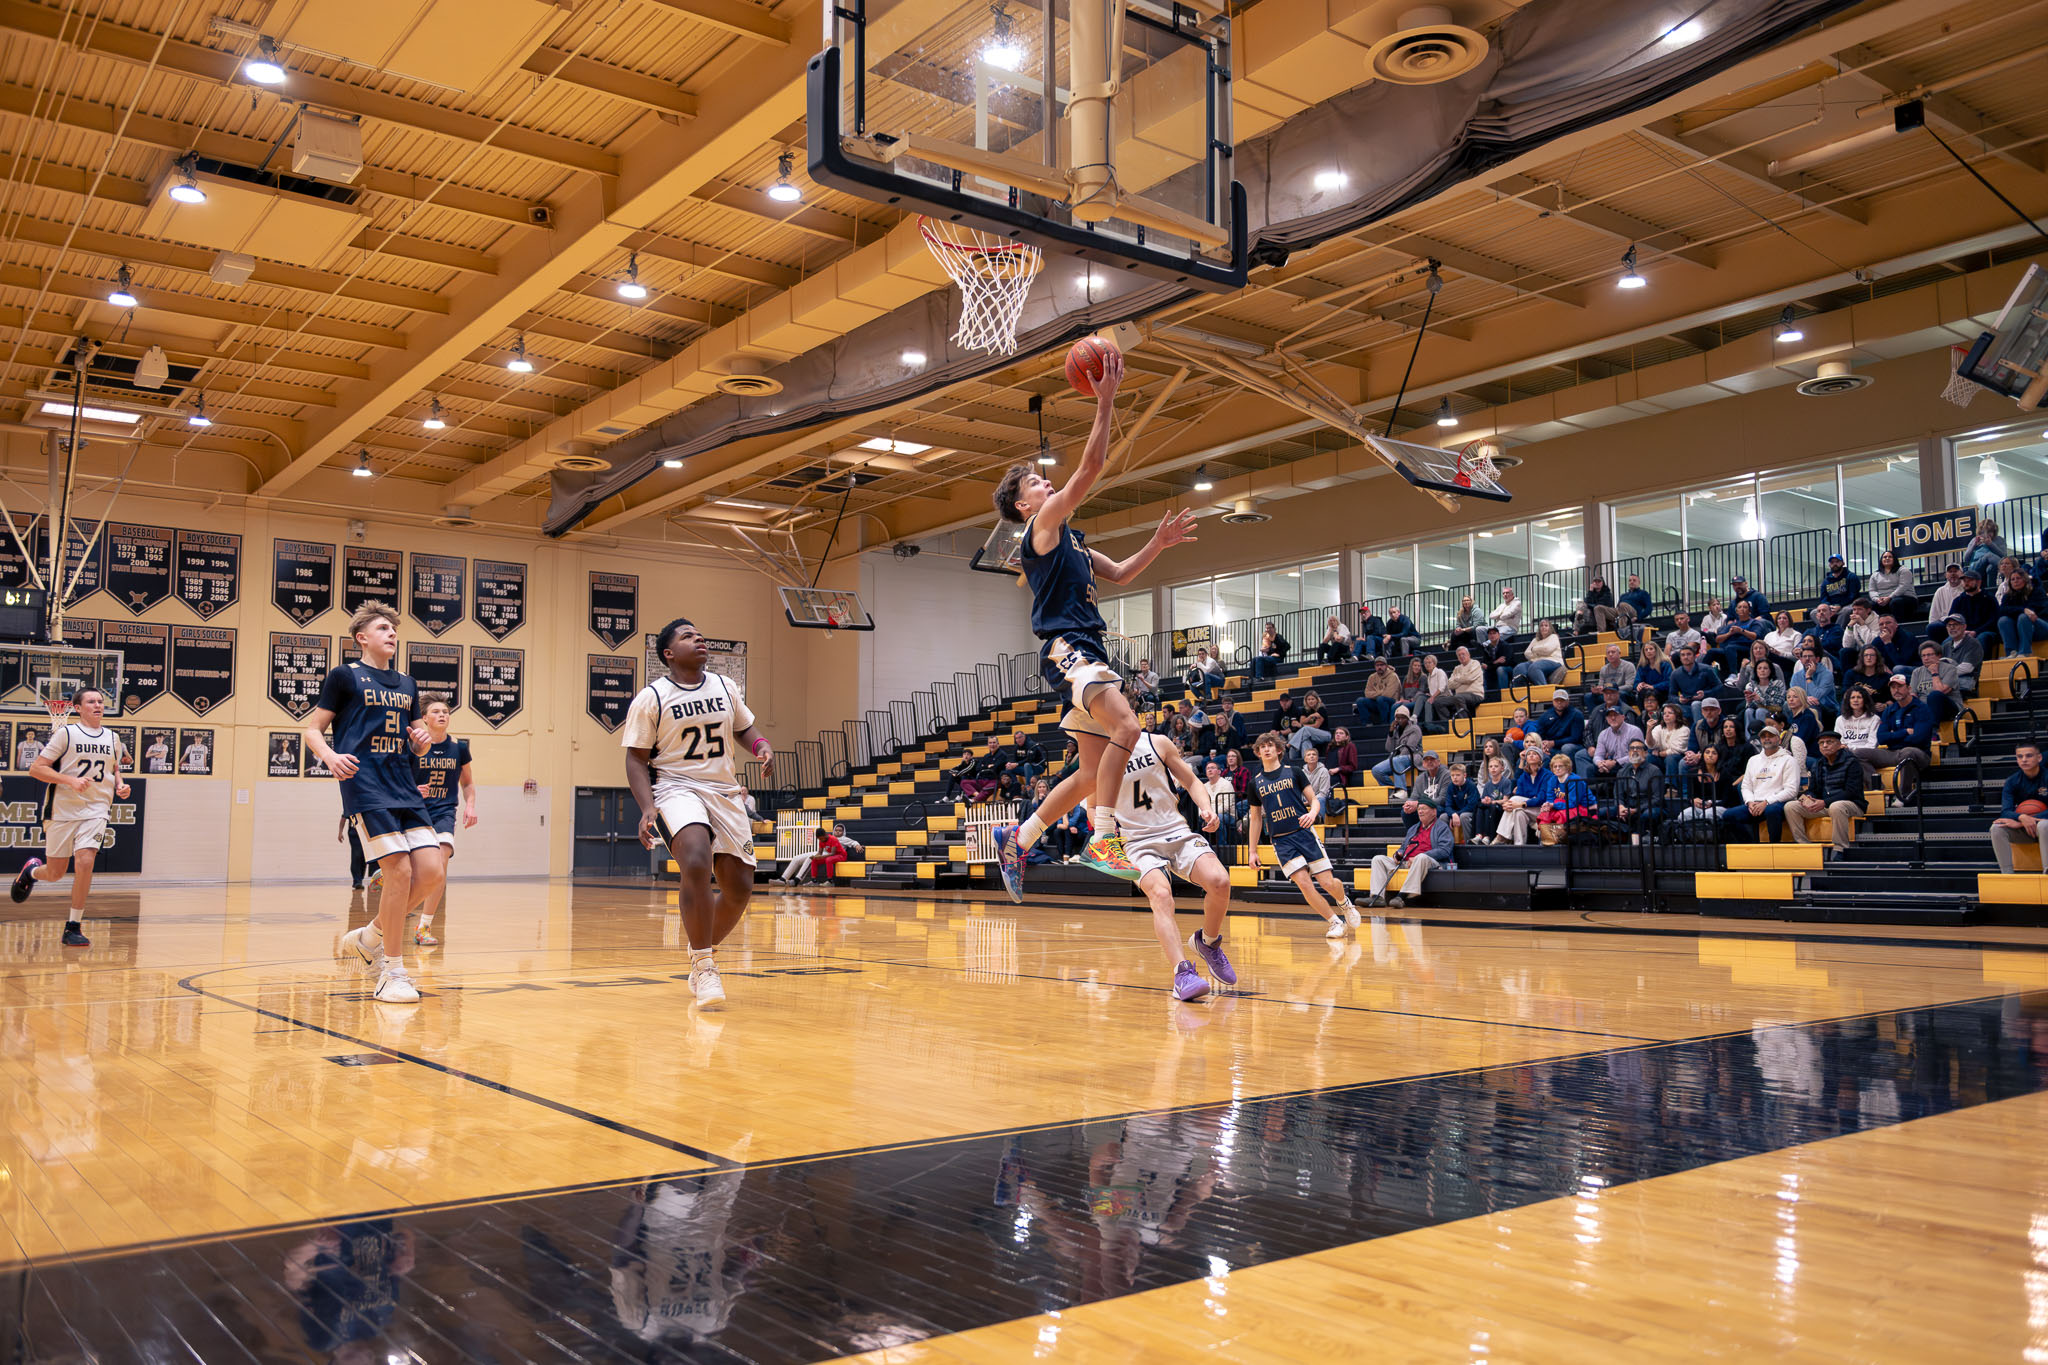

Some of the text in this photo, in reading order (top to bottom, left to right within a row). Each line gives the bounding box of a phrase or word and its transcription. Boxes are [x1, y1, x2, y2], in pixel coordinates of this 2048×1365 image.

[122, 526, 160, 538] BASEBALL
[1894, 516, 1972, 547] HOME
[186, 534, 231, 545] BOYS SOCCER
[285, 543, 325, 554] BOYS TENNIS
[358, 551, 389, 560] BOYS GOLF
[186, 558, 205, 566] 1990
[296, 568, 312, 576] 1986
[295, 595, 312, 603] 1974
[63, 621, 93, 631] MNASTICS
[118, 624, 152, 635] SOFTBALL
[181, 628, 226, 640] GIRLS SOCCER
[1188, 626, 1209, 642] BURKE
[280, 636, 321, 646] GIRLS TENNIS
[706, 641, 732, 650] SCHOOL
[475, 650, 520, 659] GIRLS SWIMMING
[364, 689, 413, 710] ELKHORN
[670, 697, 726, 720] BURKE
[385, 711, 400, 733] 21
[681, 721, 724, 760] 25
[76, 744, 110, 755] BURKE
[419, 758, 456, 769] ELKHORN
[1123, 753, 1155, 775] RKE
[78, 759, 105, 782] 23
[429, 771, 446, 785] 23
[427, 787, 448, 799] OUTH
[1258, 778, 1293, 797] ELKHORN
[1133, 779, 1152, 810] 4
[1277, 794, 1282, 807] 1
[1271, 806, 1297, 822] SOUTH
